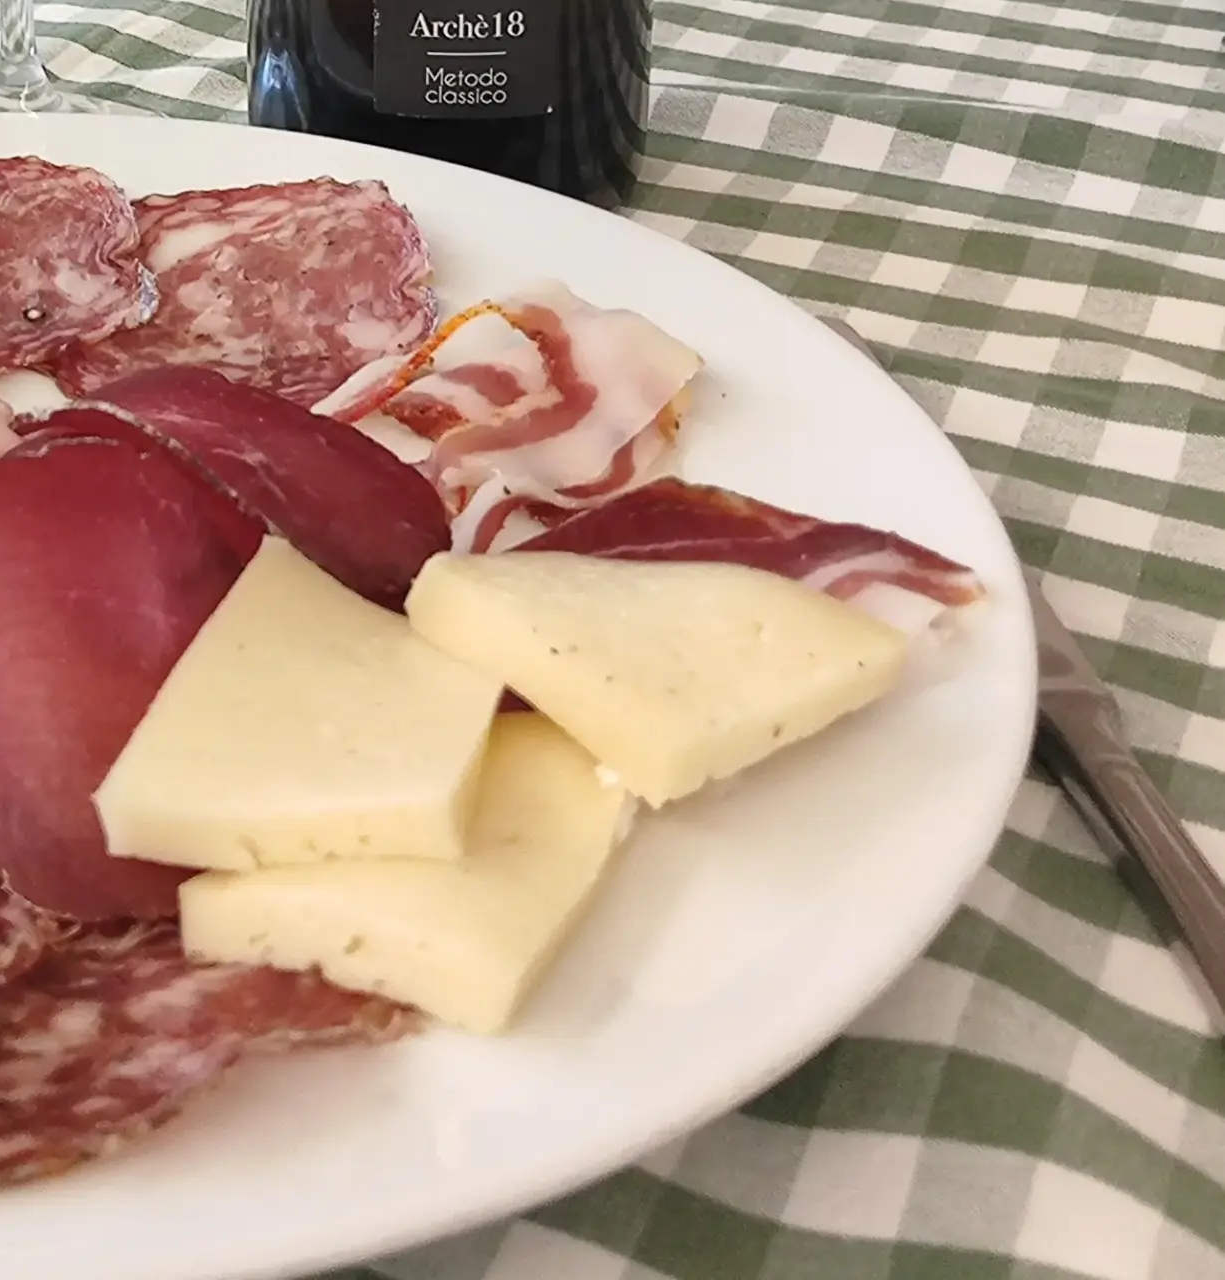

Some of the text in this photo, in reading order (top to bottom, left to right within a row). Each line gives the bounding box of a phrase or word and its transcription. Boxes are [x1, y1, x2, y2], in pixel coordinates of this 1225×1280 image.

[409, 10, 525, 39] Archè18
[425, 67, 507, 87] Metodo
[425, 85, 507, 105] classico
